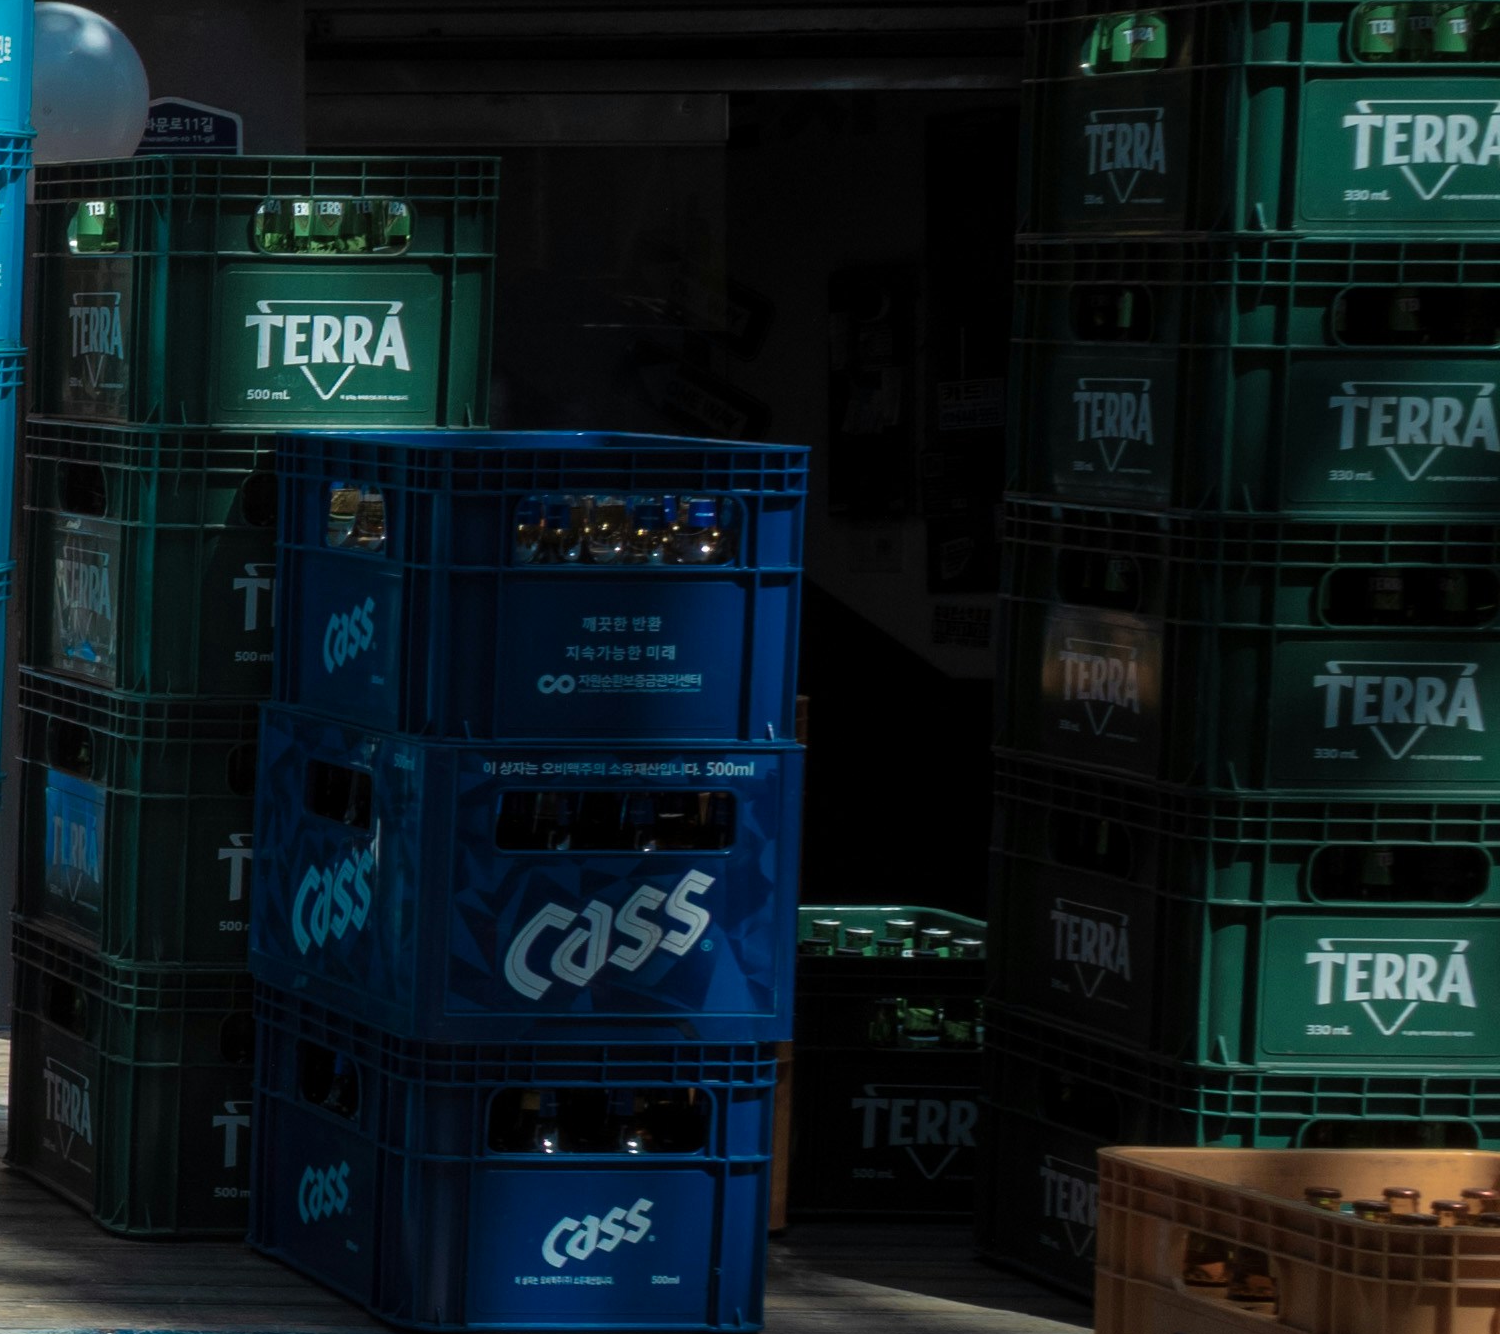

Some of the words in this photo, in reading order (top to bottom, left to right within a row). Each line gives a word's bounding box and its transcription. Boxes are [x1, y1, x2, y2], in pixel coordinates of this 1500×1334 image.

[247, 389, 270, 400] 500
[323, 595, 376, 674] Cass
[581, 616, 627, 633] 깨끗한
[632, 616, 663, 633] 반환
[565, 644, 643, 662] 지속가능한
[647, 644, 677, 662] 미래
[706, 761, 756, 777] 500ml
[291, 848, 373, 956] Cass
[503, 868, 717, 1002] Cass
[298, 1160, 351, 1225] Cass
[541, 1197, 656, 1269] Cass
[651, 1274, 681, 1285] 500ml
